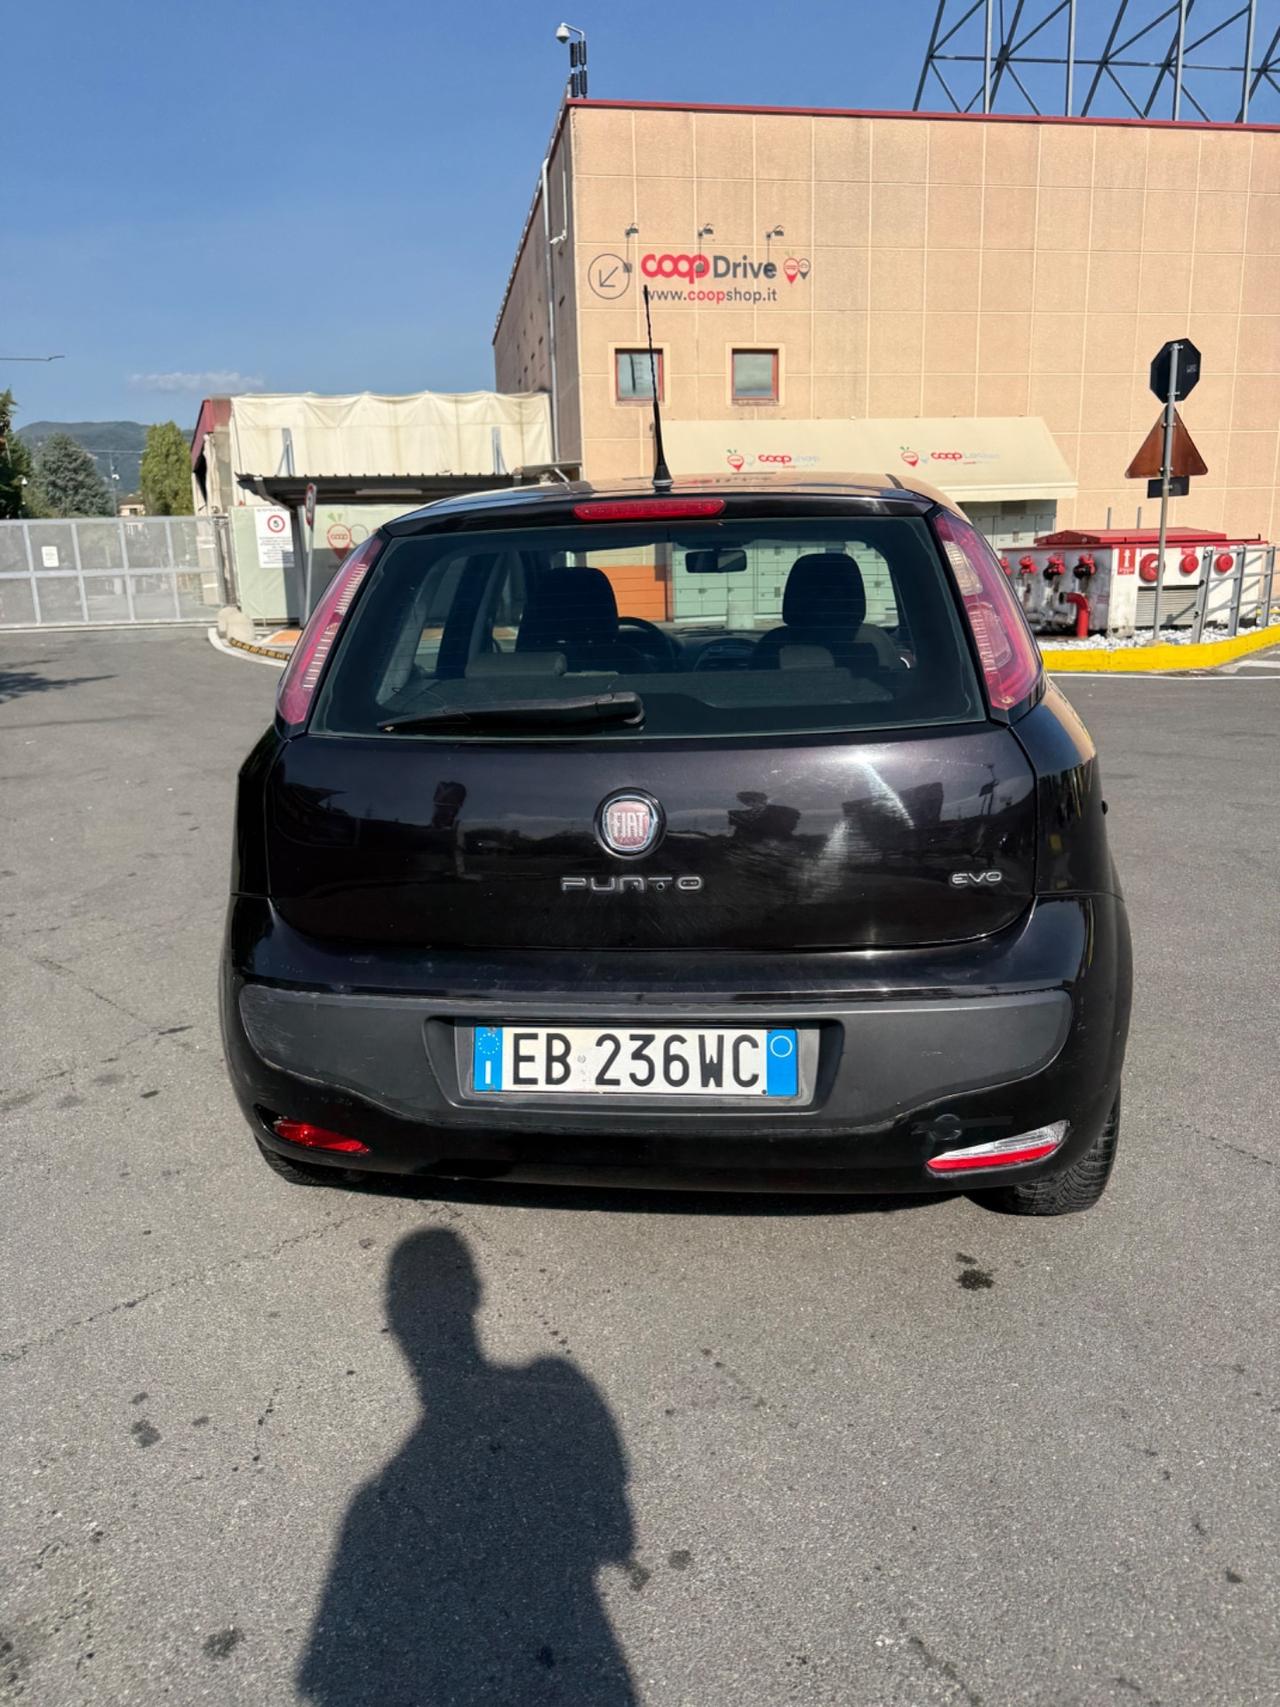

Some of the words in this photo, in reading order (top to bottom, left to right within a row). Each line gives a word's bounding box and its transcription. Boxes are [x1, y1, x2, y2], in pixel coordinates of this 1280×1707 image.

[713, 255, 777, 279] Drive
[643, 287, 777, 303] www.coopshop.it
[612, 811, 647, 838] FIAT
[561, 876, 703, 891] PUNTO
[513, 1032, 572, 1086] EB
[595, 1033, 760, 1088] 236WC
